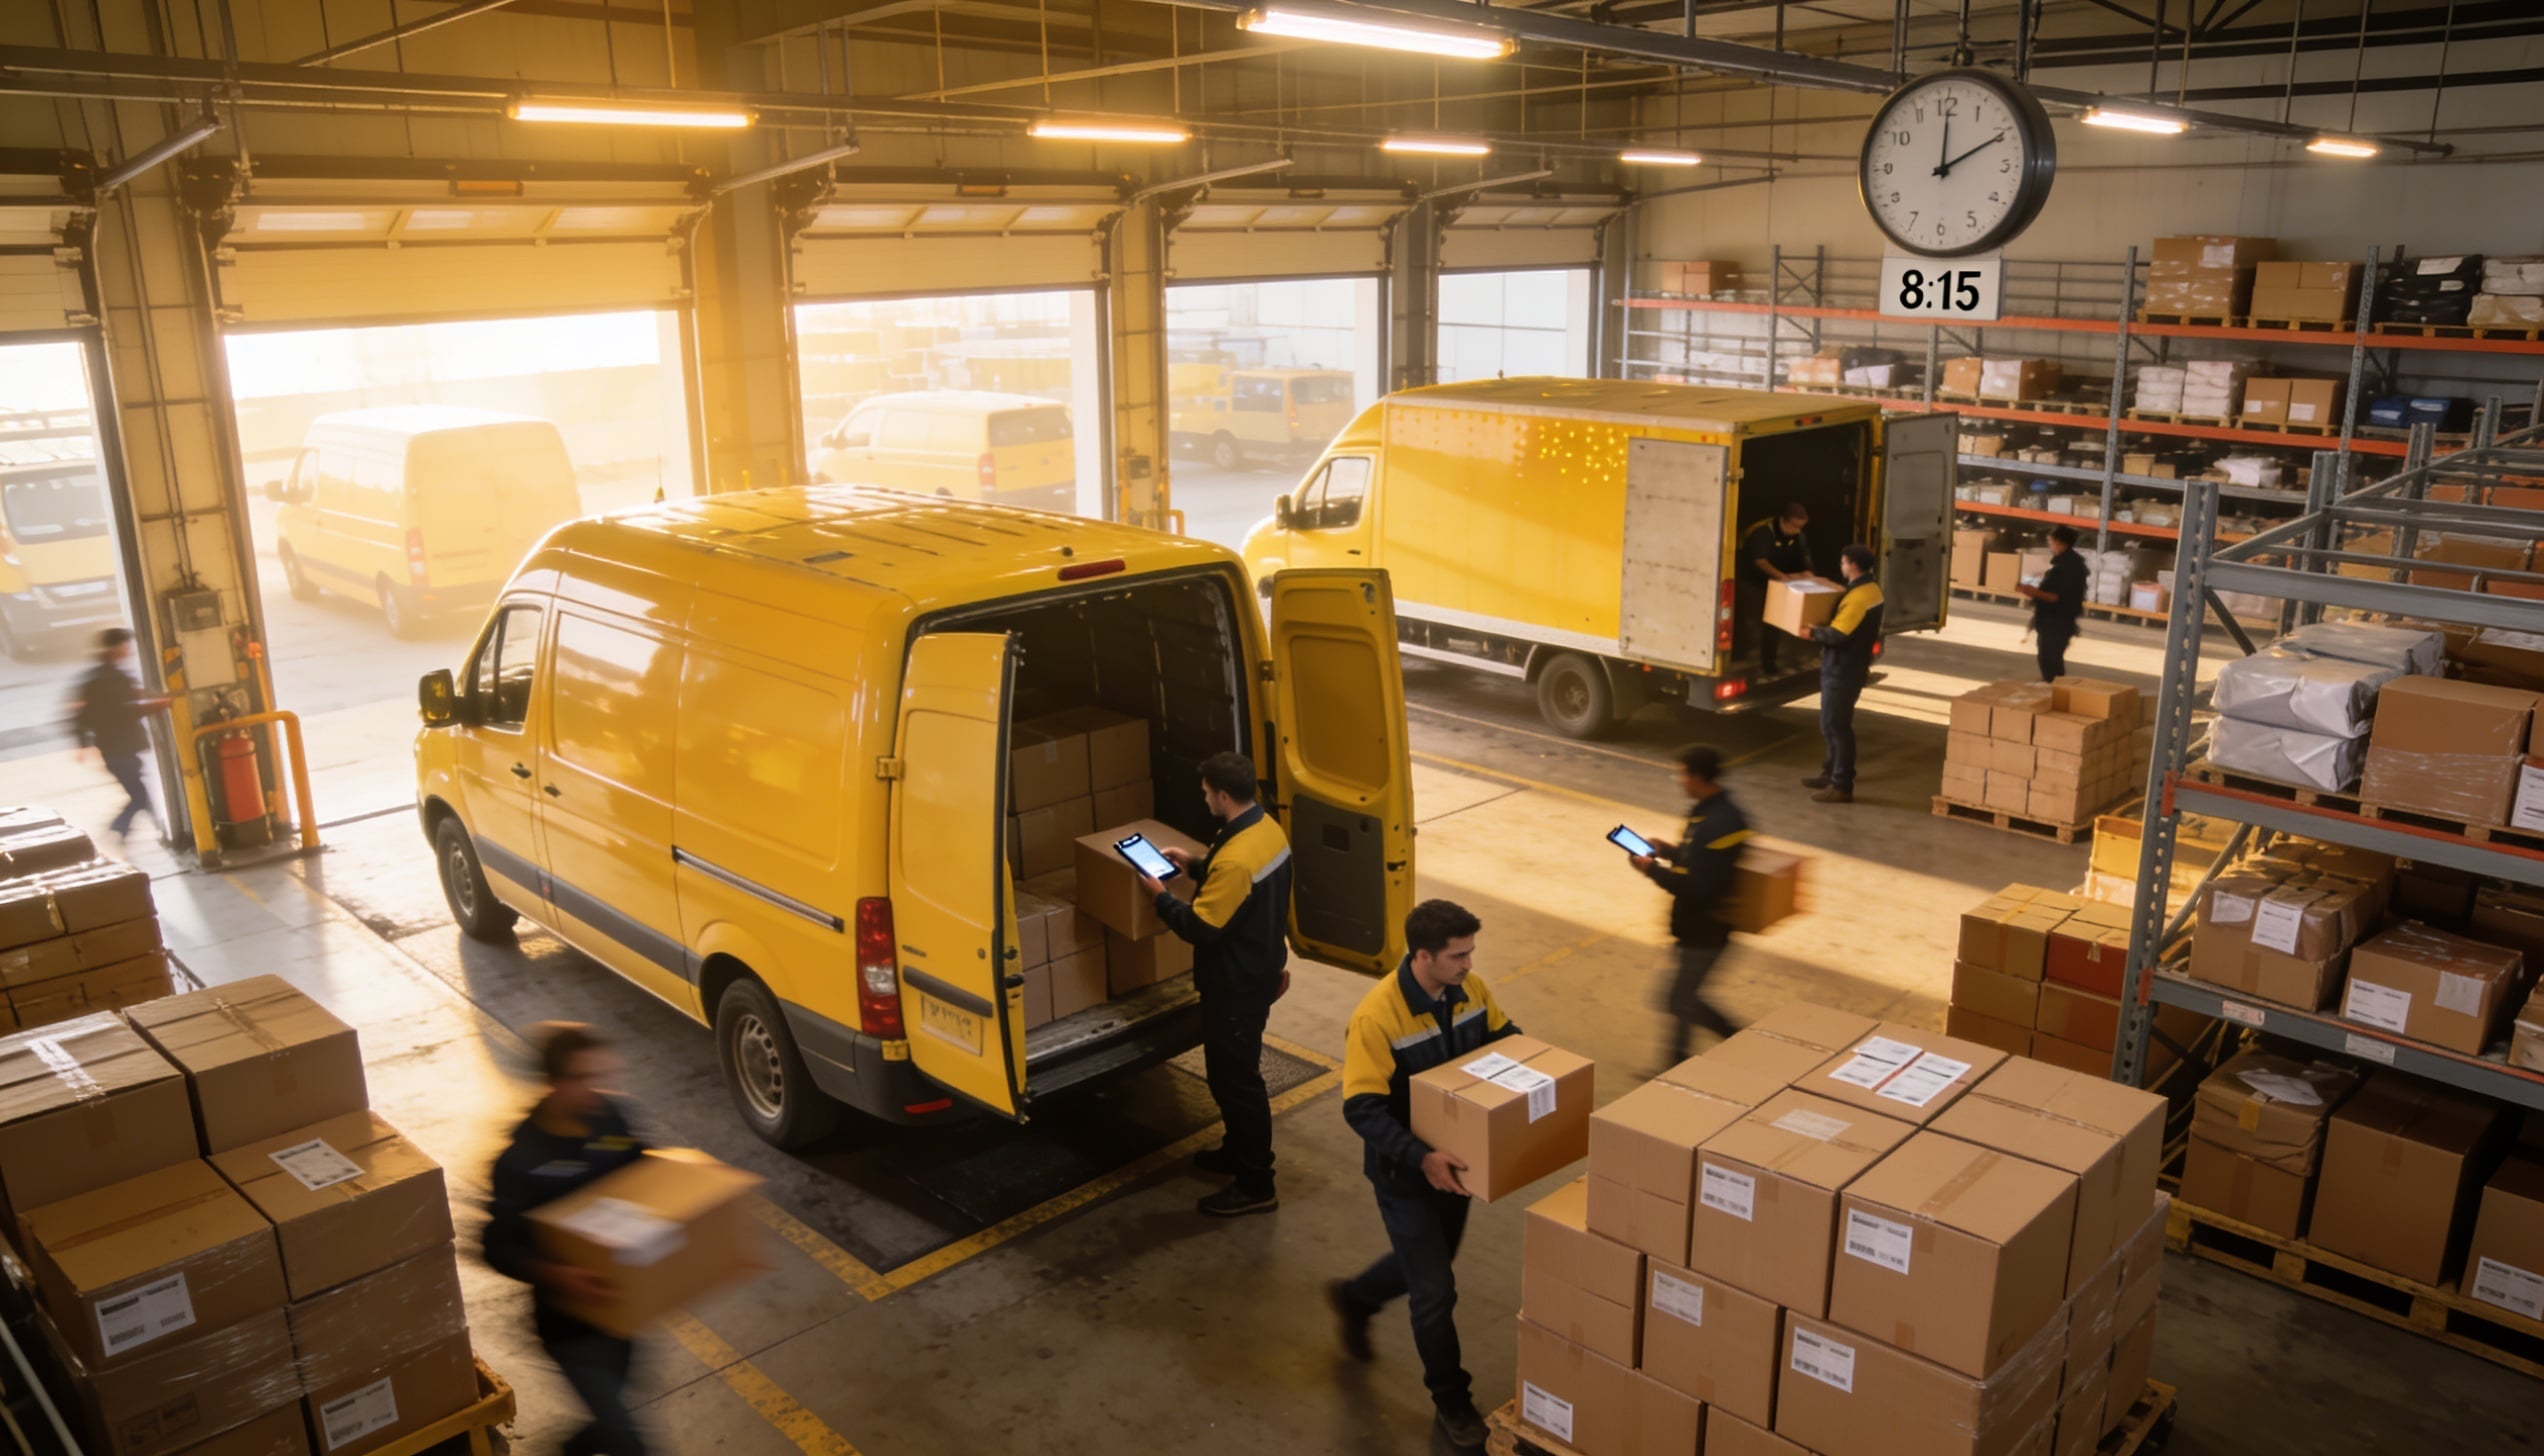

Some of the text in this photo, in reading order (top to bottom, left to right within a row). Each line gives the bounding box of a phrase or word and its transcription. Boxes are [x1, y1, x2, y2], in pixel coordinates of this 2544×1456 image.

[1938, 97, 1958, 116] 12
[1892, 130, 1910, 146] 10
[2000, 158, 2010, 174] 3
[1909, 210, 1919, 232] 7
[1967, 210, 1977, 228] 5
[1899, 269, 1981, 311] 8:15
